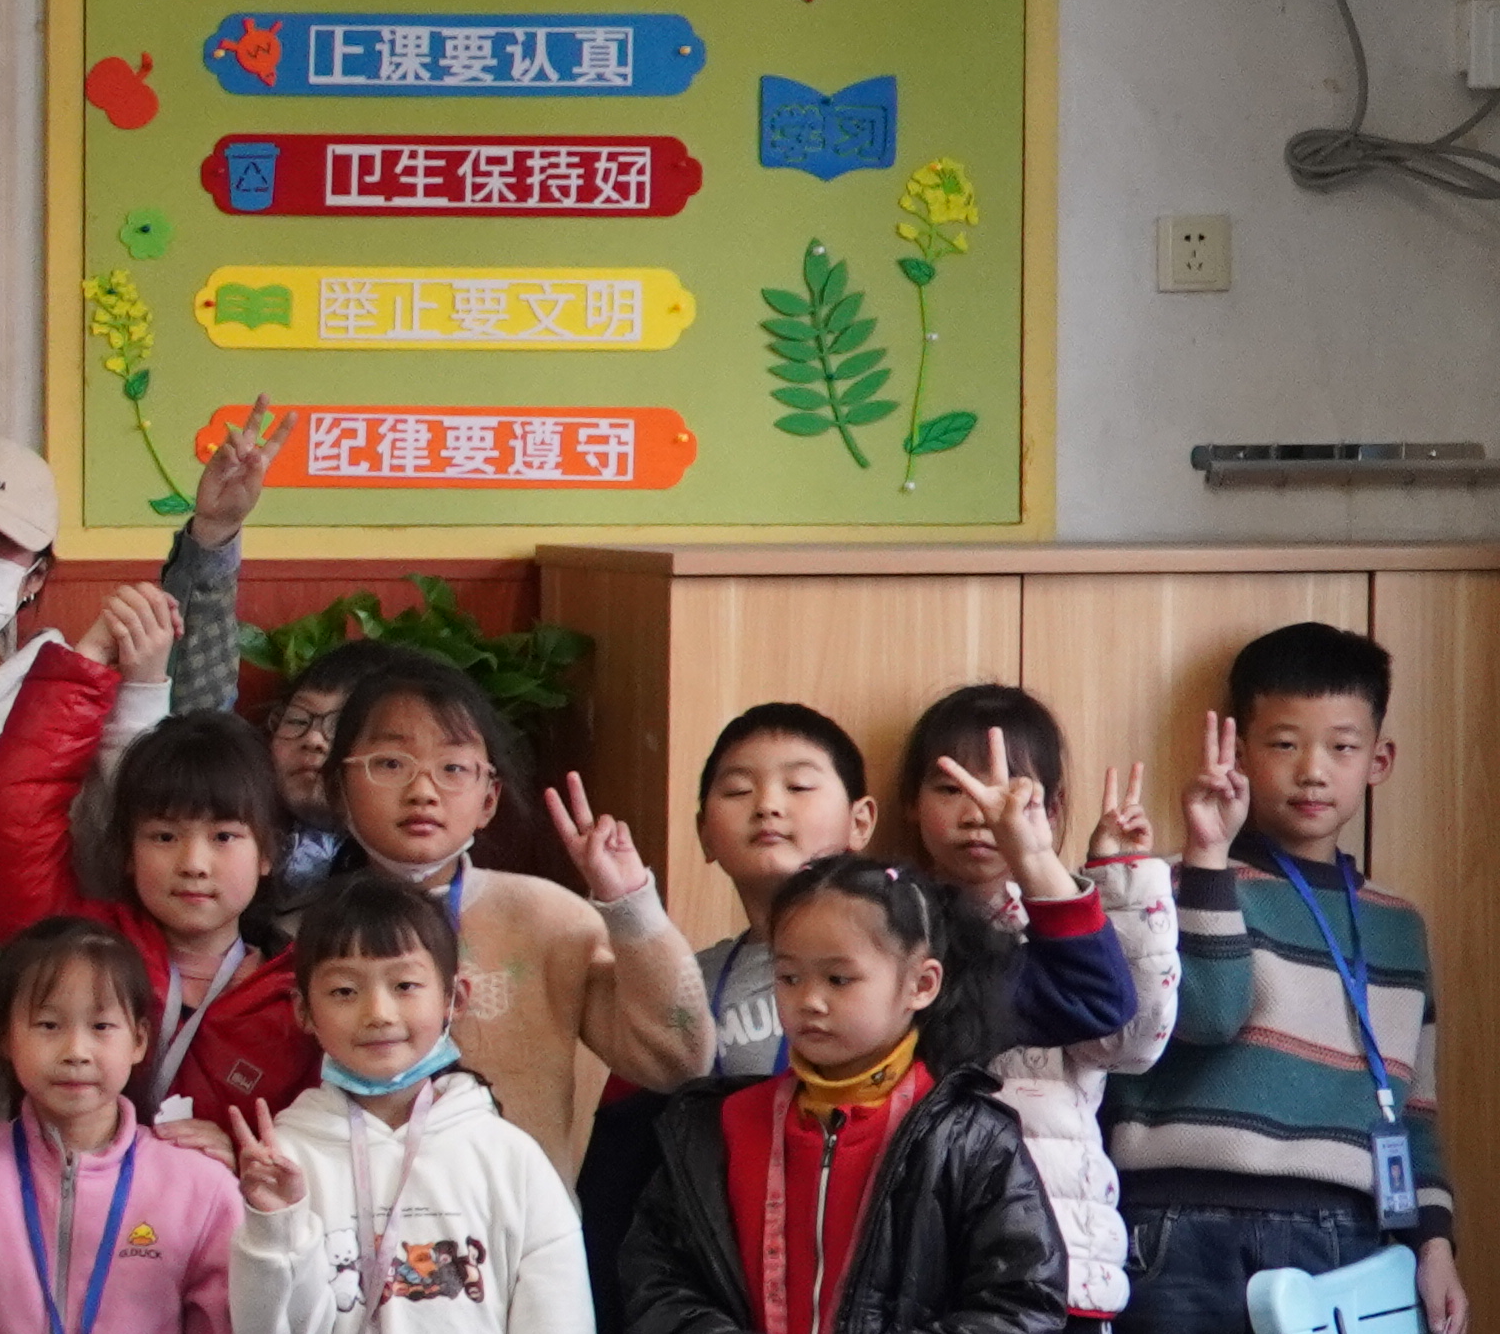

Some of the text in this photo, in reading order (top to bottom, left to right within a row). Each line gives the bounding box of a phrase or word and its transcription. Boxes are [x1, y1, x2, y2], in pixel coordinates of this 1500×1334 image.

[311, 27, 632, 86] 上课要认真
[326, 146, 650, 208] 卫生保持好
[322, 280, 642, 341] 举止要文明
[309, 415, 635, 480] 纪律要遵守
